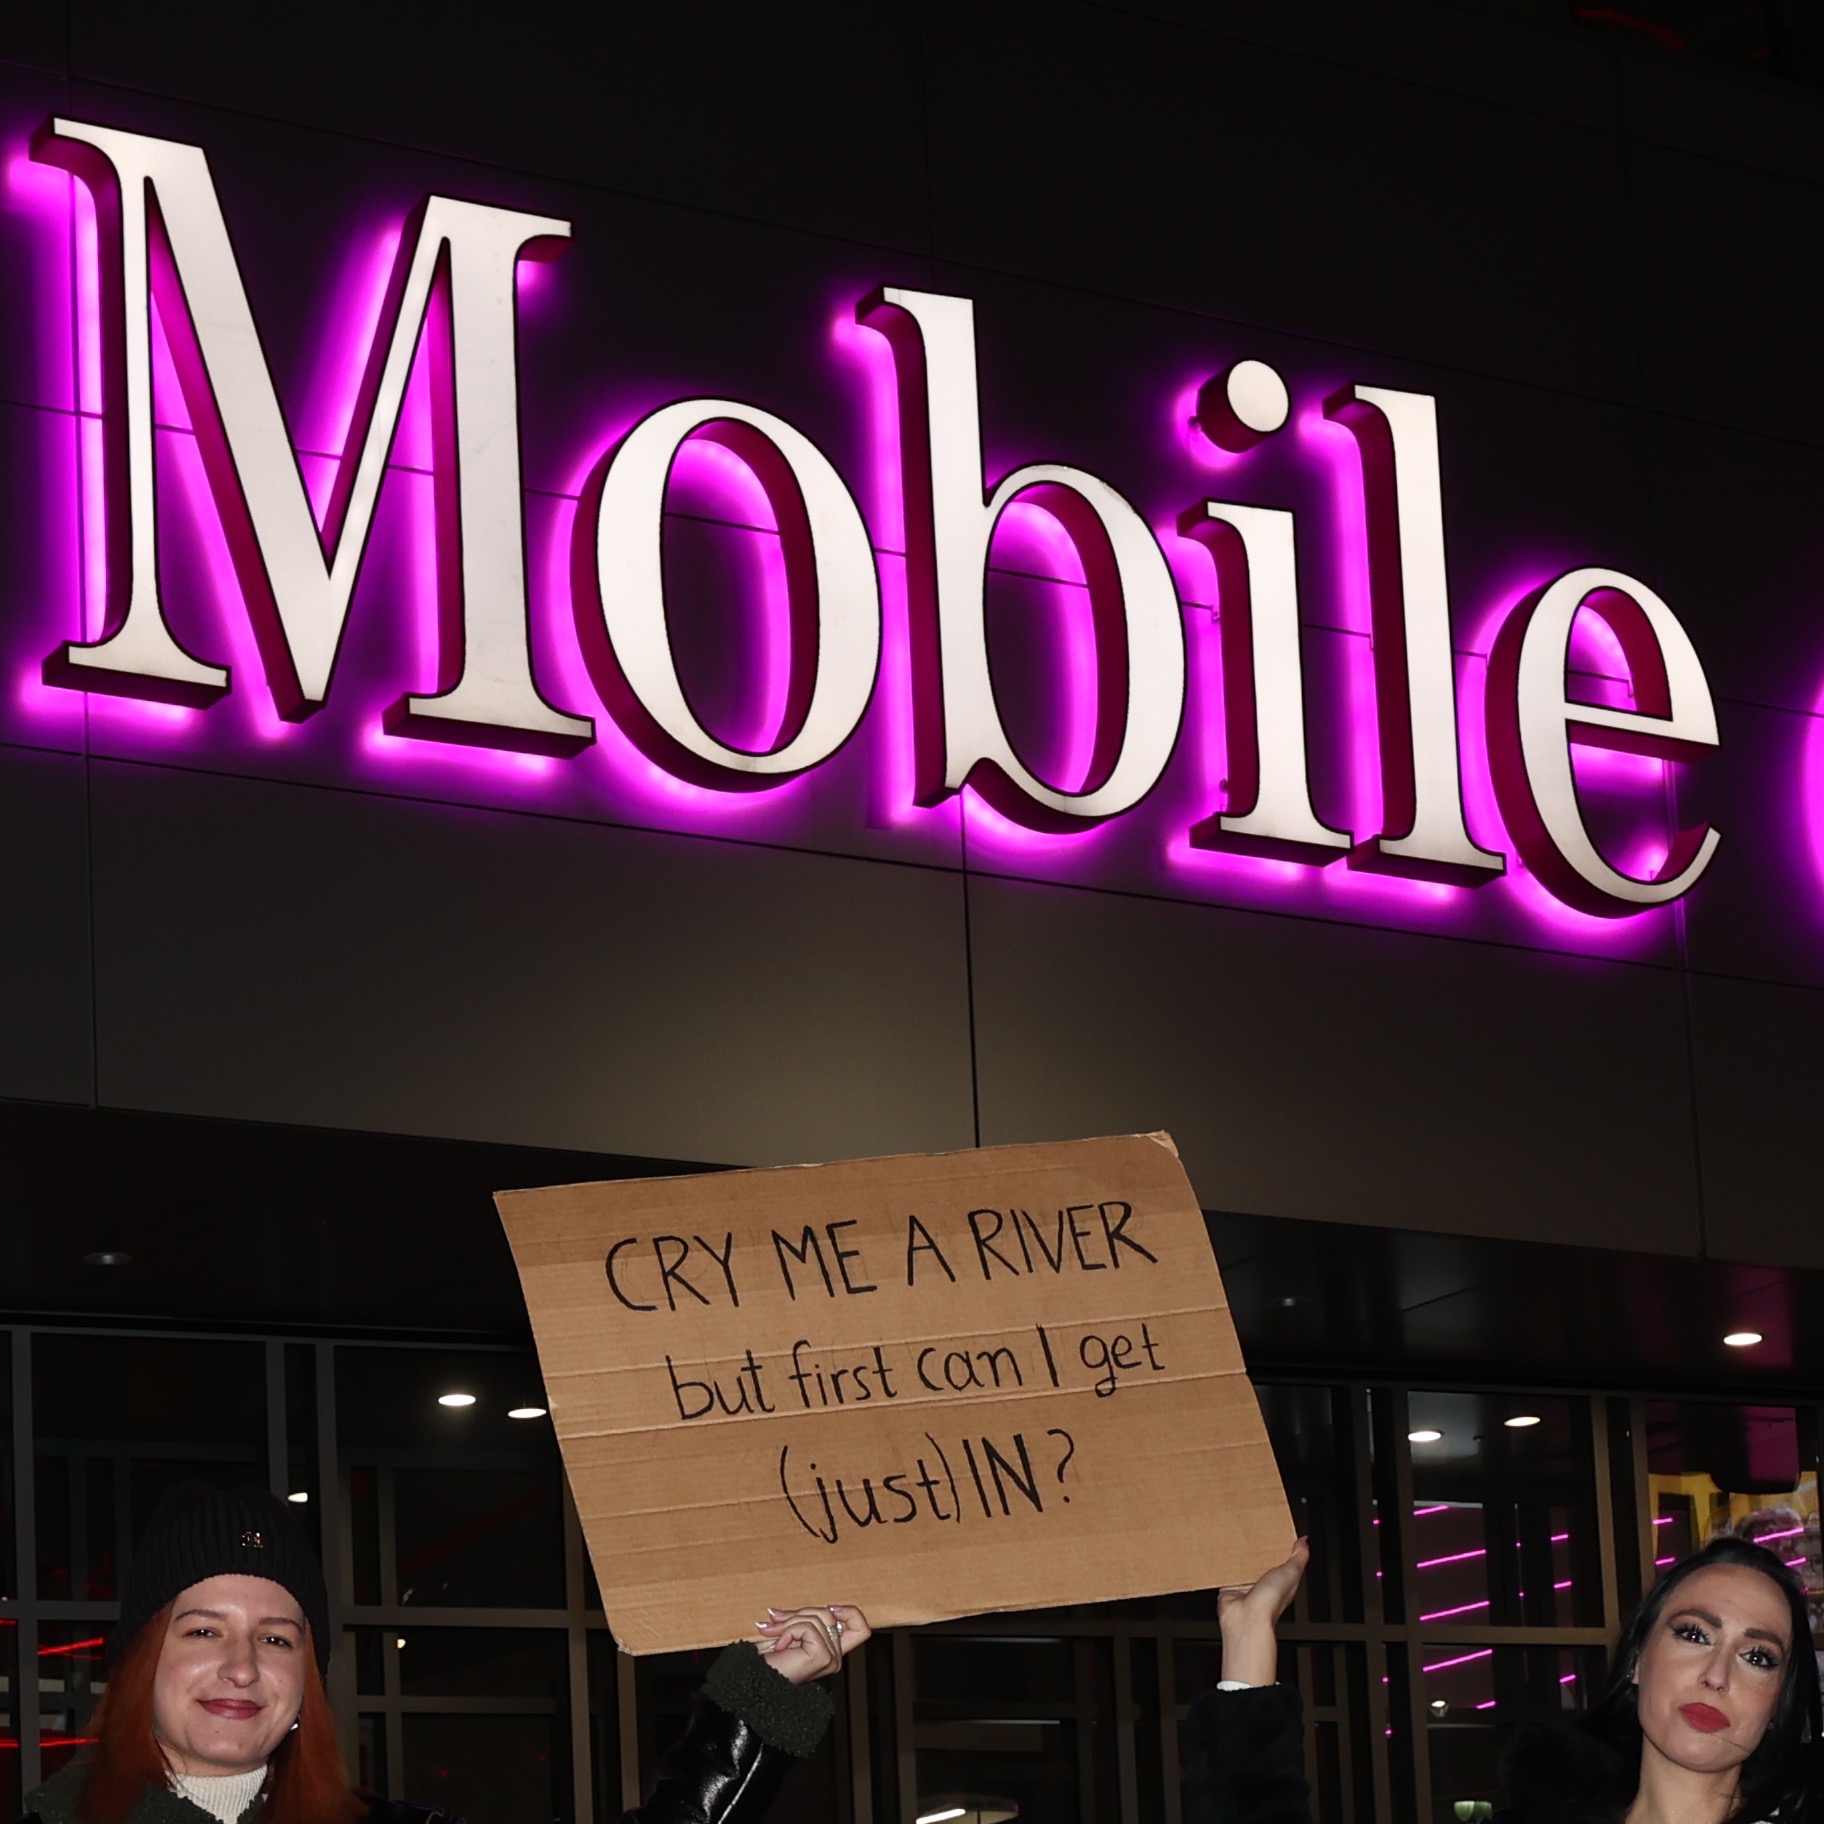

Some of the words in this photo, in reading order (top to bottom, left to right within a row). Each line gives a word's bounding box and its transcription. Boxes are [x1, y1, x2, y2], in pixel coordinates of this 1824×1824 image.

[34, 117, 1721, 912] Mobile
[607, 1233, 738, 1312] CRY
[771, 1218, 877, 1299] ME
[908, 1214, 955, 1287] A
[969, 1200, 1159, 1280] RIVER
[667, 1349, 775, 1420] but
[789, 1340, 895, 1410] first
[917, 1345, 1026, 1393] can
[1036, 1325, 1061, 1387] I
[1080, 1322, 1166, 1397] get
